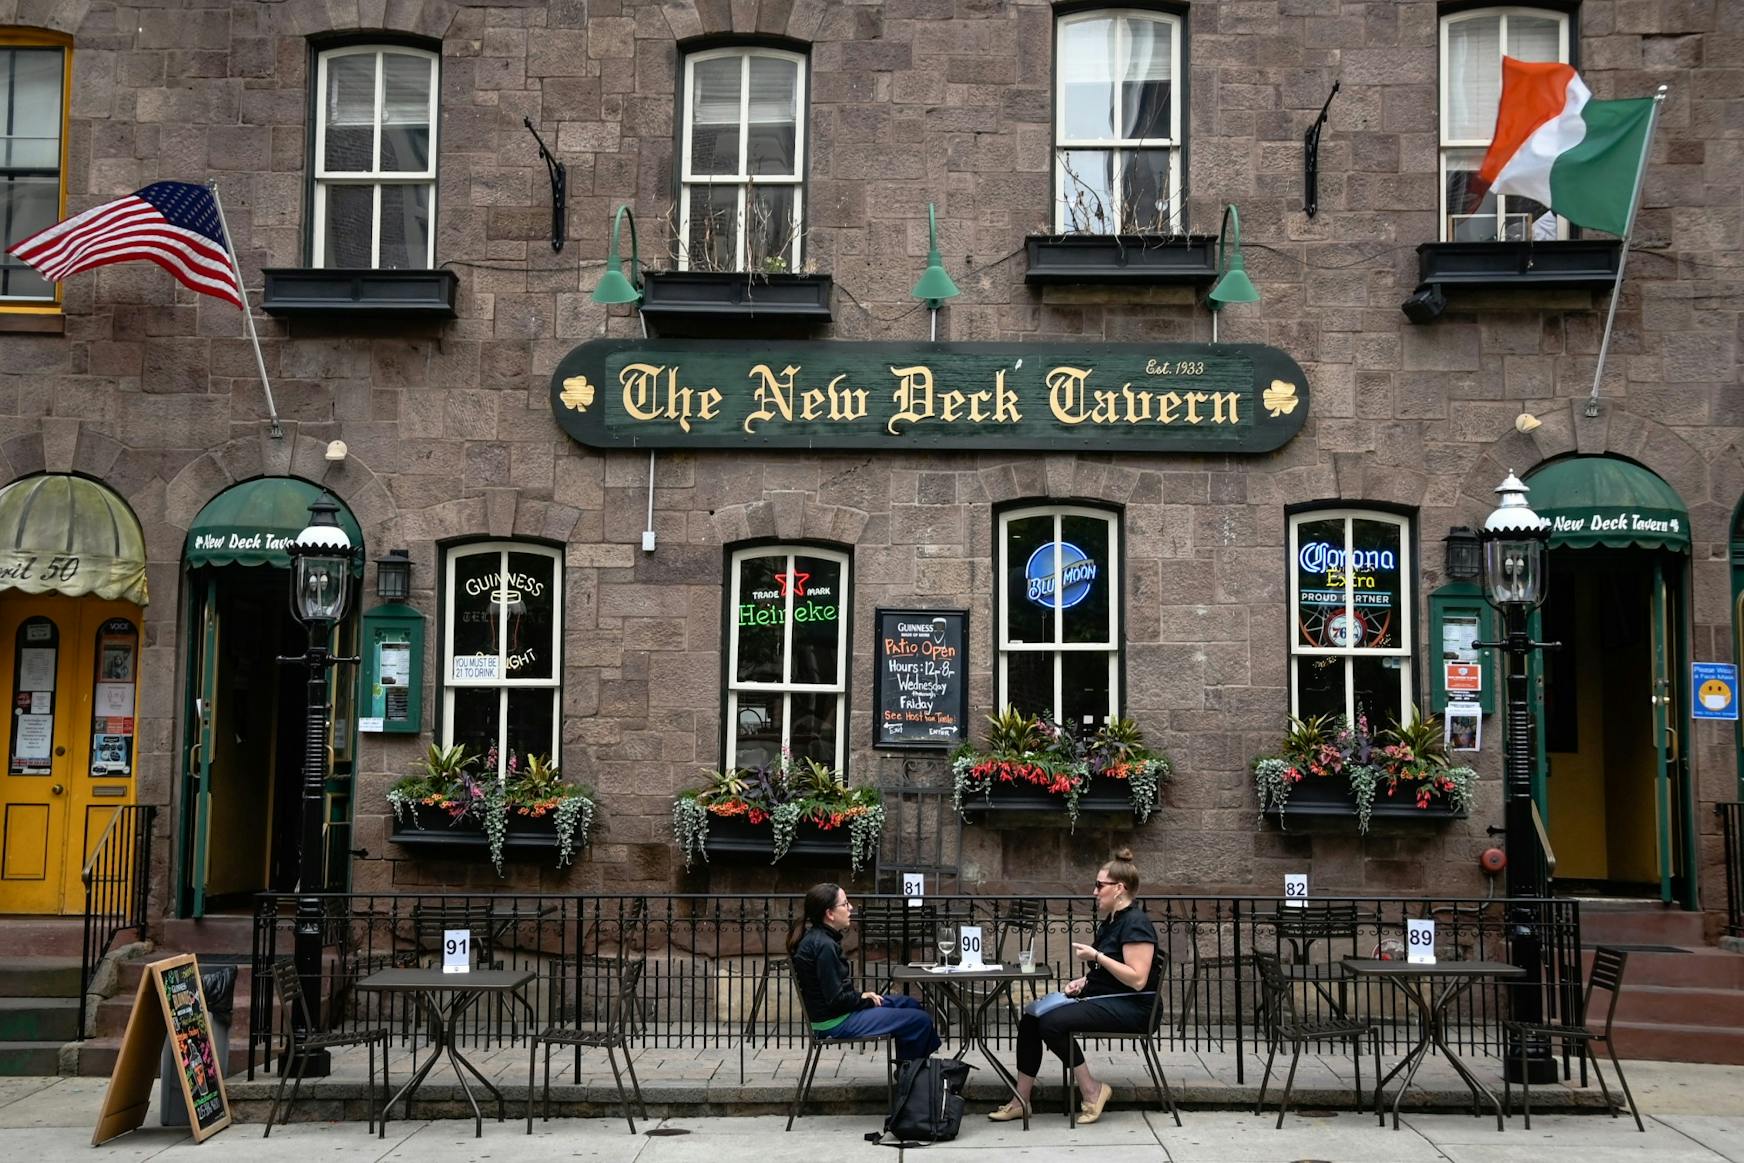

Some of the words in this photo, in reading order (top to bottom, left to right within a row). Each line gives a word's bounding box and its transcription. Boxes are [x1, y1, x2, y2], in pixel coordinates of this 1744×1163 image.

[1145, 359, 1172, 375] Est.
[1175, 360, 1204, 375] 1933
[619, 363, 723, 433] The
[744, 363, 871, 434] New
[887, 365, 1023, 436] Deck
[1045, 365, 1241, 426] Tavern
[1553, 515, 1585, 532] New
[1590, 513, 1628, 531] Deck
[1632, 514, 1668, 532] Tavern
[202, 533, 225, 550] New
[229, 533, 262, 550] Deck
[265, 533, 295, 550] Tave
[1299, 542, 1395, 573] Corona
[0, 556, 38, 580] ril
[40, 556, 80, 582] 50
[465, 572, 544, 597] GUINNESS
[1028, 577, 1056, 600] BLU
[1063, 564, 1097, 586] MOON
[752, 590, 780, 600] TRADE
[807, 587, 831, 597] MARK
[1301, 592, 1338, 602] PROUD
[1342, 593, 1390, 604] PRTNER
[738, 600, 839, 627] Heieke
[897, 622, 935, 633] GUINNESS
[921, 640, 956, 661] Open
[455, 657, 468, 668] YOU
[469, 657, 487, 668] MUST
[488, 657, 497, 668] BE
[455, 667, 463, 678] 21
[464, 667, 474, 678] TO
[474, 667, 496, 678] DRINK
[896, 672, 947, 696] Wednesday
[905, 881, 921, 895] 81
[1286, 882, 1305, 896] 82
[962, 936, 980, 952] 90
[1409, 929, 1433, 946] 89
[446, 938, 466, 955] 91
